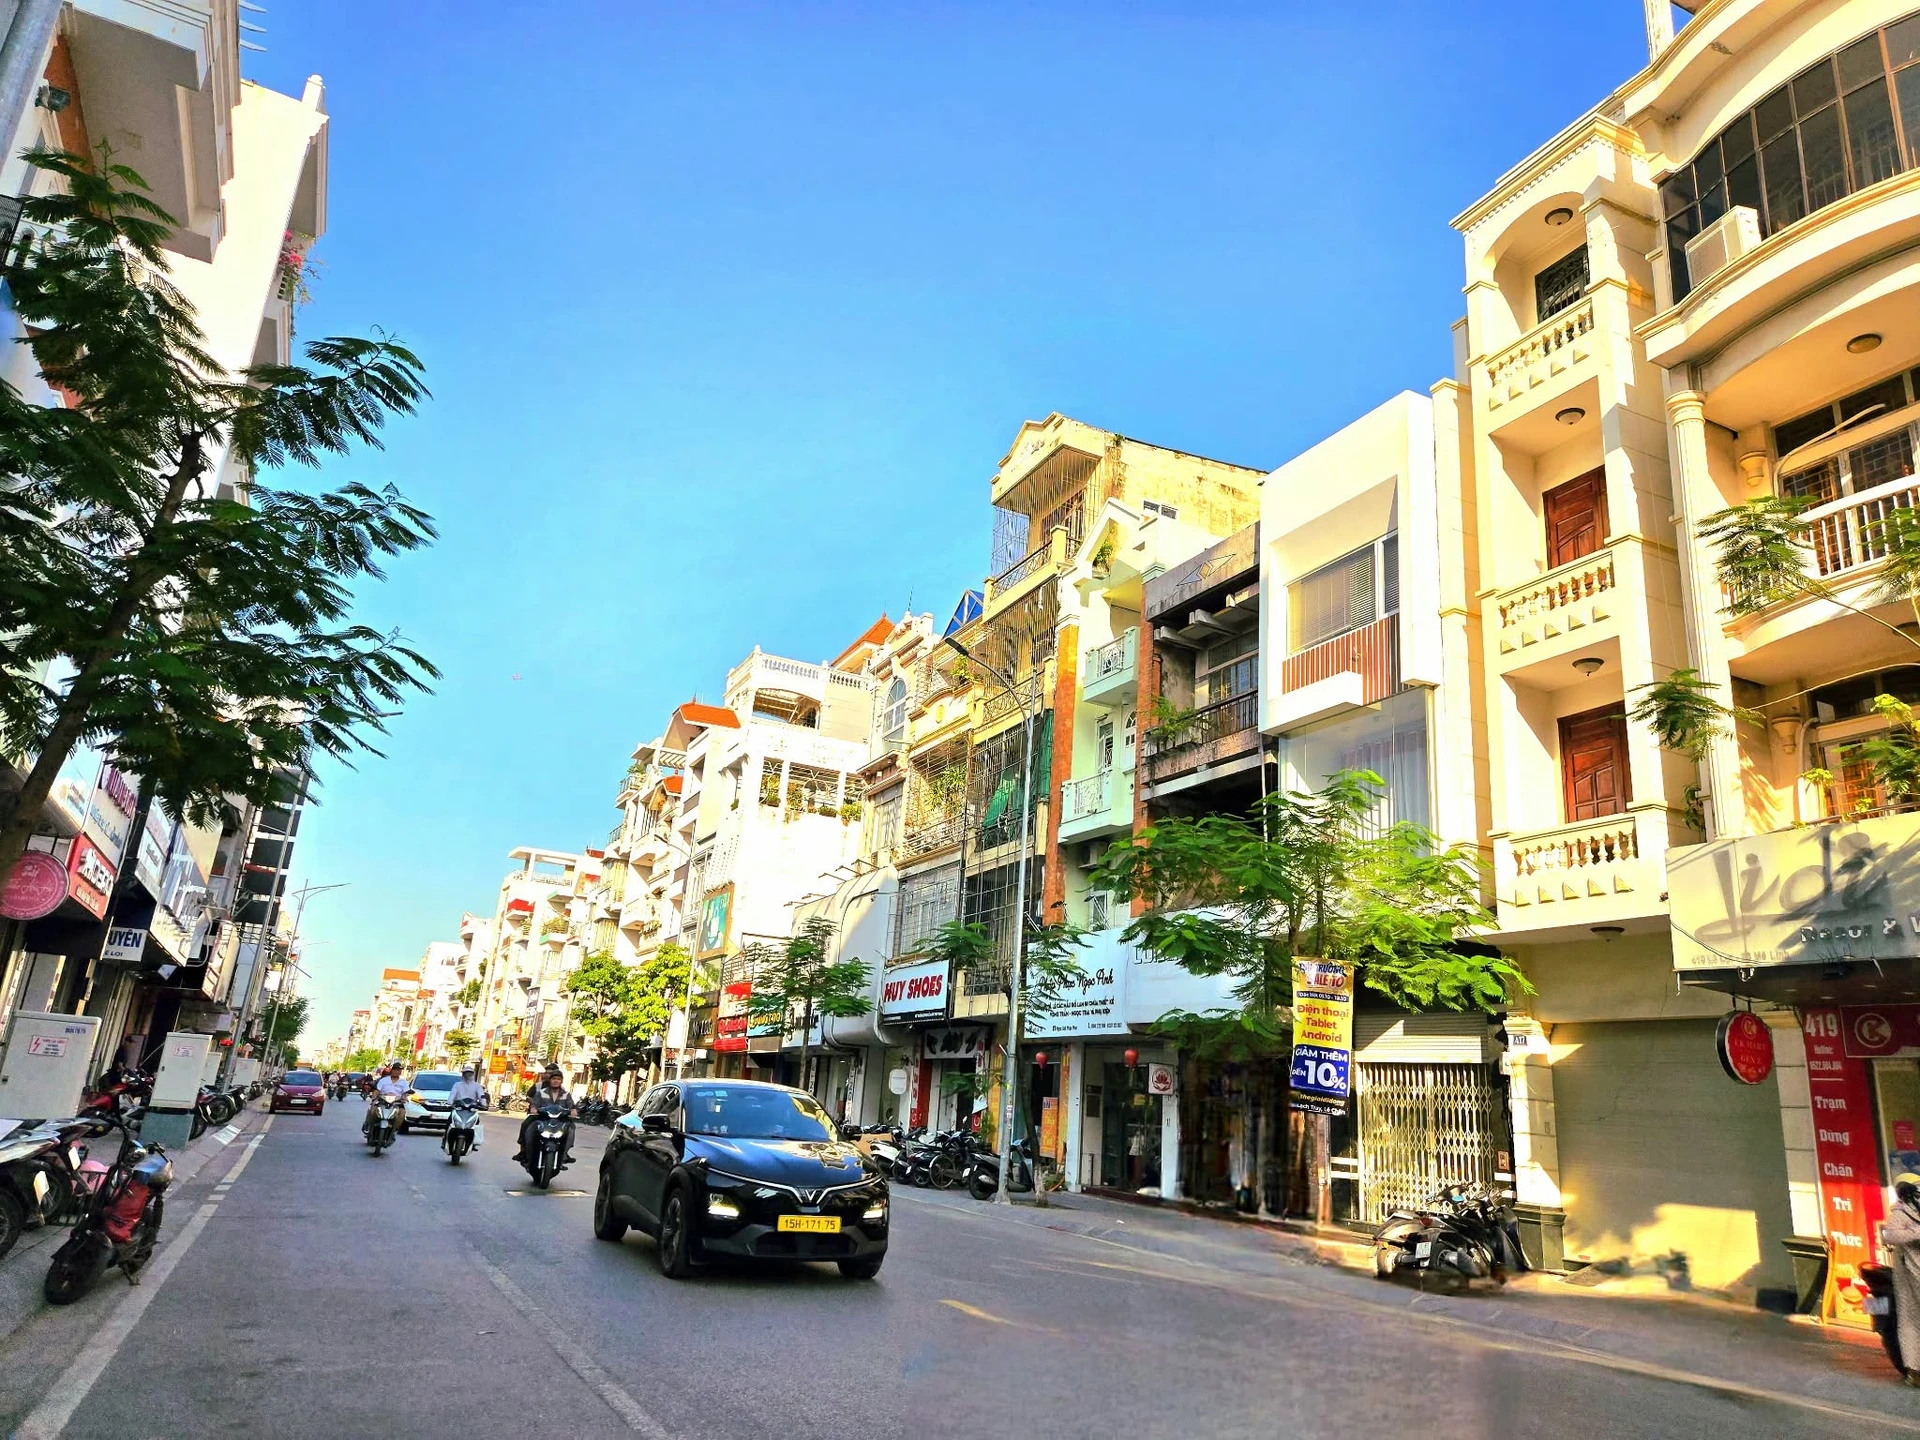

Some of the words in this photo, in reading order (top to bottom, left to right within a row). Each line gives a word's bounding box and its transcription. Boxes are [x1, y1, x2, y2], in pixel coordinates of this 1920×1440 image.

[884, 981, 907, 1002] HUY
[907, 974, 943, 999] SHOES
[1297, 1004, 1320, 1016] Điện
[1322, 1006, 1349, 1020] thoại
[1306, 1017, 1337, 1030] Tablet
[1805, 1012, 1839, 1037] 419
[1301, 1030, 1342, 1043] Android
[1320, 1050, 1348, 1062] THÊM
[1815, 1095, 1847, 1112] Trạm
[1819, 1128, 1850, 1147] Dừng
